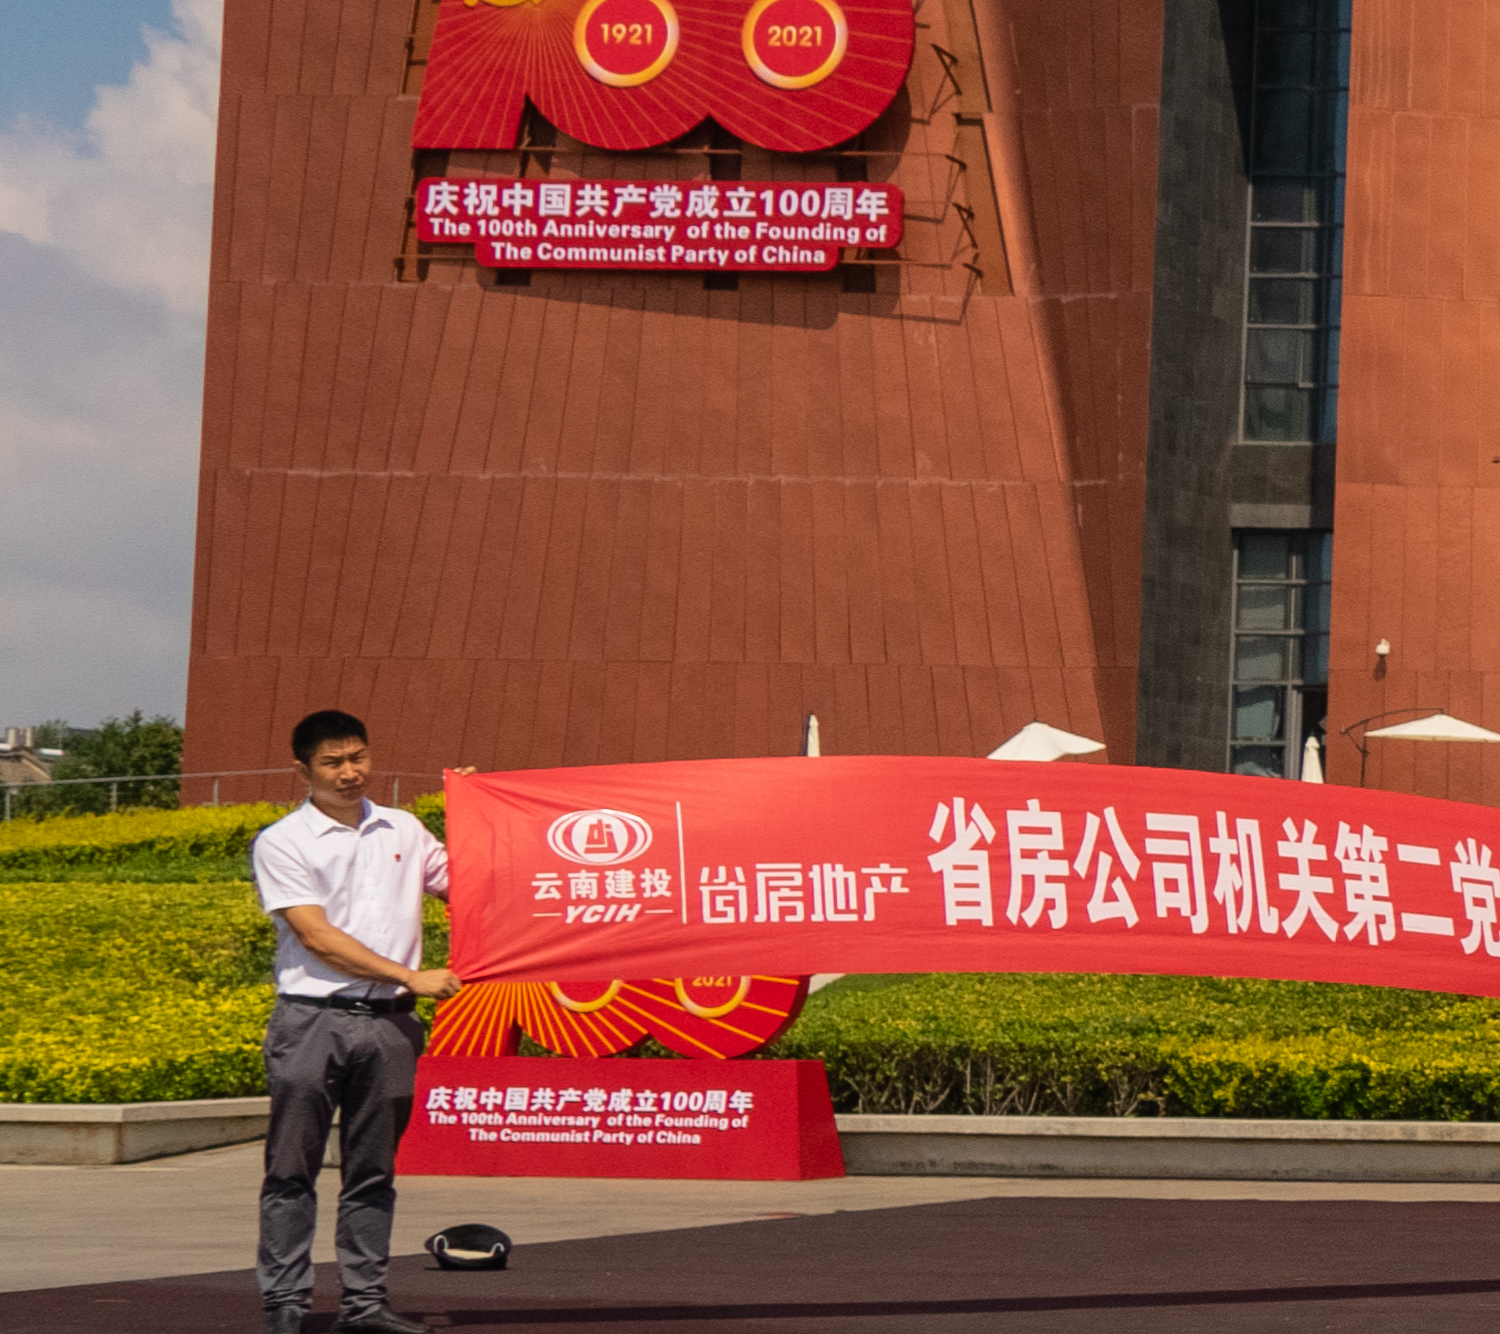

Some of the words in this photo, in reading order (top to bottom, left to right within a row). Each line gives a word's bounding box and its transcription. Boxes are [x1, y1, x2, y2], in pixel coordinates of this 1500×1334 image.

[600, 23, 654, 45] 1921
[767, 26, 823, 48] 2021
[425, 181, 889, 222] 庆祝中国共产党成立100周年
[429, 217, 471, 236] The
[477, 219, 537, 237] 100th
[543, 220, 675, 243] Anniversary
[686, 221, 710, 239] of
[714, 222, 750, 240] the
[755, 222, 860, 244] Founding
[865, 224, 887, 242] of
[491, 242, 532, 260] The
[537, 243, 666, 262] Communist
[671, 245, 729, 266] Party
[734, 245, 757, 263] of
[762, 246, 826, 264] China
[531, 867, 673, 900] 云南建投
[565, 903, 642, 924] YCIH
[425, 1086, 754, 1114] 庆祝中国共产党成立100周年
[428, 1111, 457, 1125] The
[461, 1112, 503, 1126] 100th
[506, 1112, 600, 1128] Anniversary
[607, 1113, 624, 1127] of
[626, 1114, 652, 1127] the
[655, 1114, 729, 1130] Founding
[731, 1115, 748, 1128] of
[469, 1128, 497, 1141] The
[501, 1128, 590, 1143] Communist
[593, 1130, 634, 1145] Party
[637, 1130, 654, 1144] of
[656, 1131, 701, 1144] China
